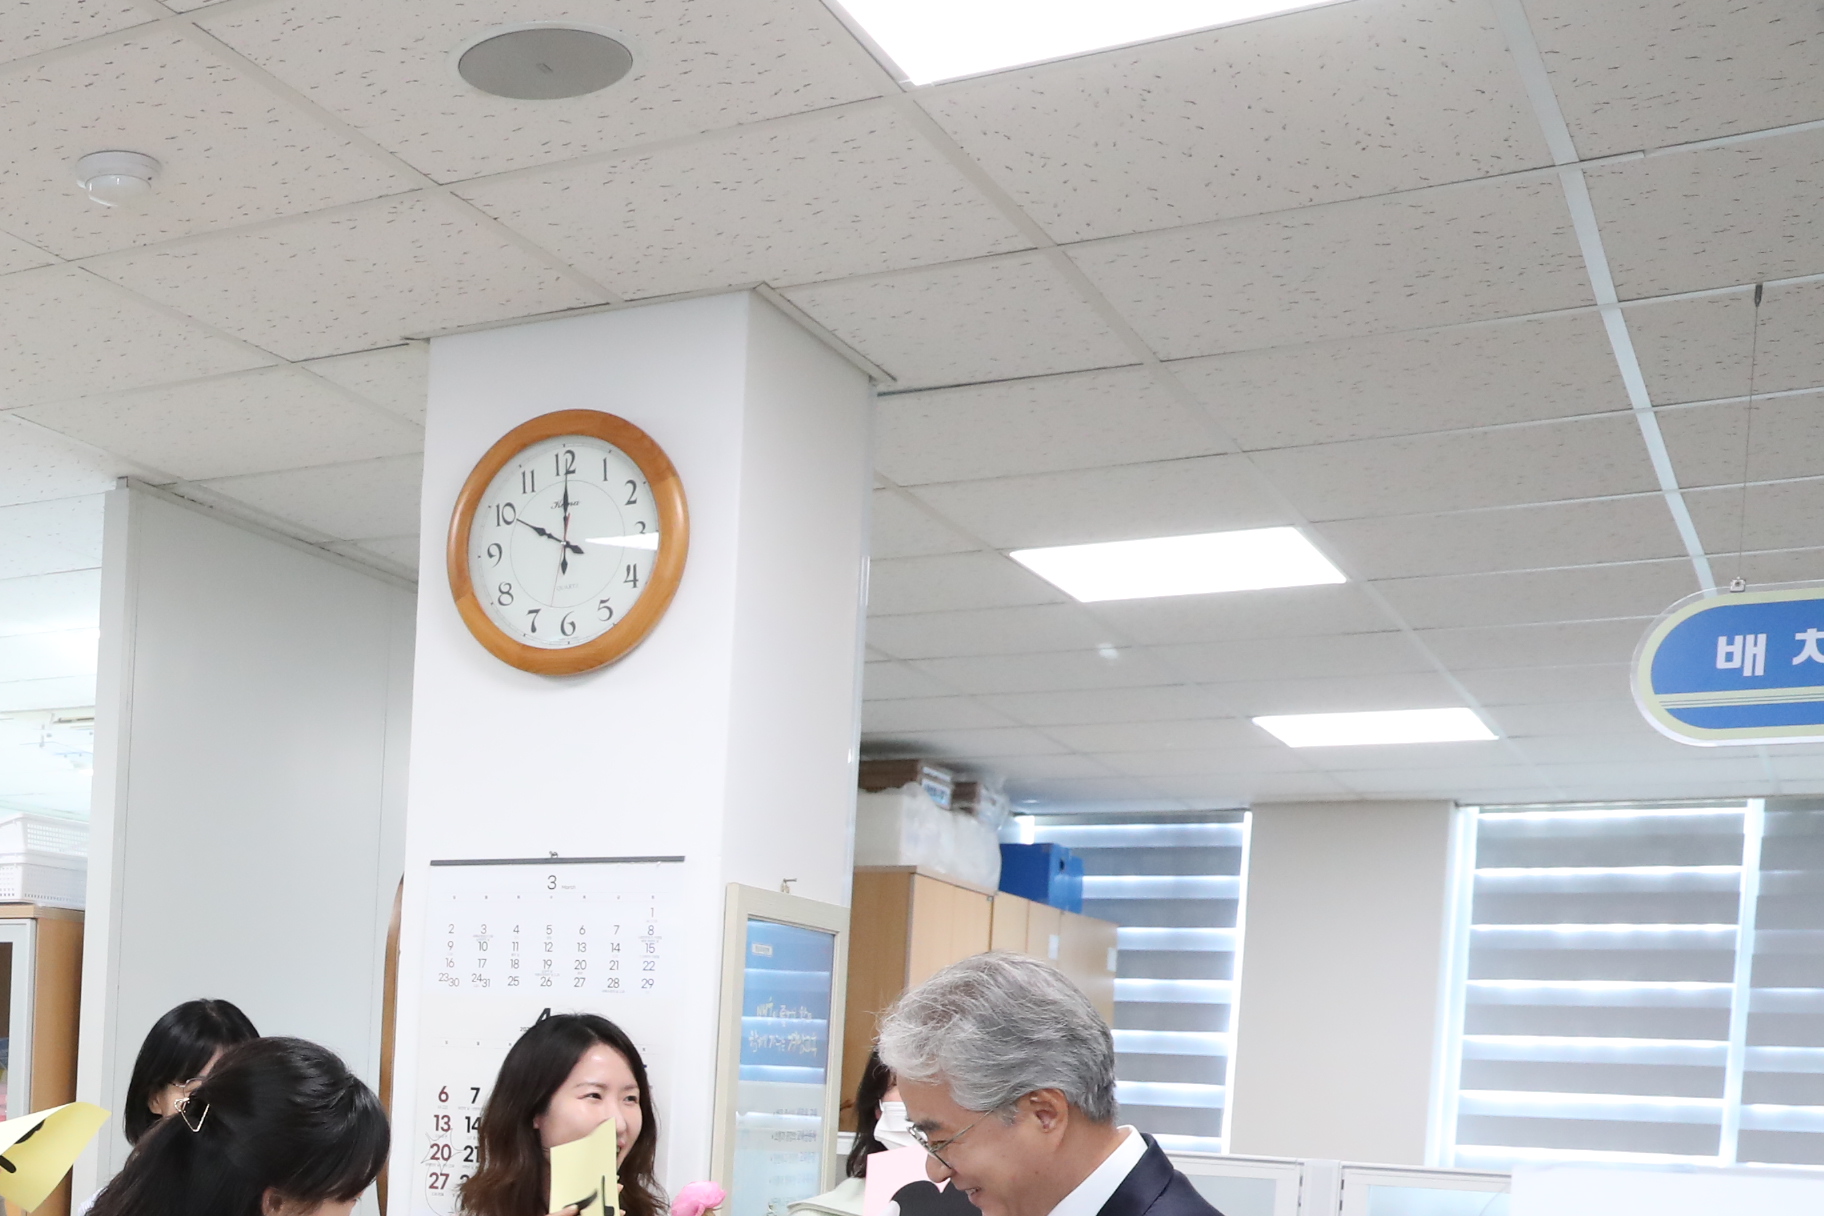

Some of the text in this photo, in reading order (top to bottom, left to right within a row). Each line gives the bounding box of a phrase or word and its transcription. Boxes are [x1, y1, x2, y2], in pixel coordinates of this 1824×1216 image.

[555, 450, 576, 476] 12
[603, 457, 609, 482] 1
[521, 469, 536, 494] 11
[624, 479, 637, 506] 2
[496, 502, 517, 527] 10
[487, 543, 503, 568] 9
[623, 563, 639, 589] 4
[497, 582, 514, 606] 8
[526, 608, 541, 633] 7
[597, 598, 614, 621] 5
[560, 611, 576, 636] 6
[547, 874, 557, 890] 3
[448, 924, 655, 936] 2 3 4 5 6 7 8
[447, 940, 656, 954] 9 10 11 12 13 14 15
[445, 957, 656, 971] 16 17 18 19 20 21 22
[438, 972, 654, 989] 23 30 24 31 25 26 27 28 29
[438, 1086, 481, 1104] 6 7
[433, 1114, 481, 1133] 13 14
[430, 1143, 480, 1163] 20 21
[428, 1172, 450, 1190] 27
